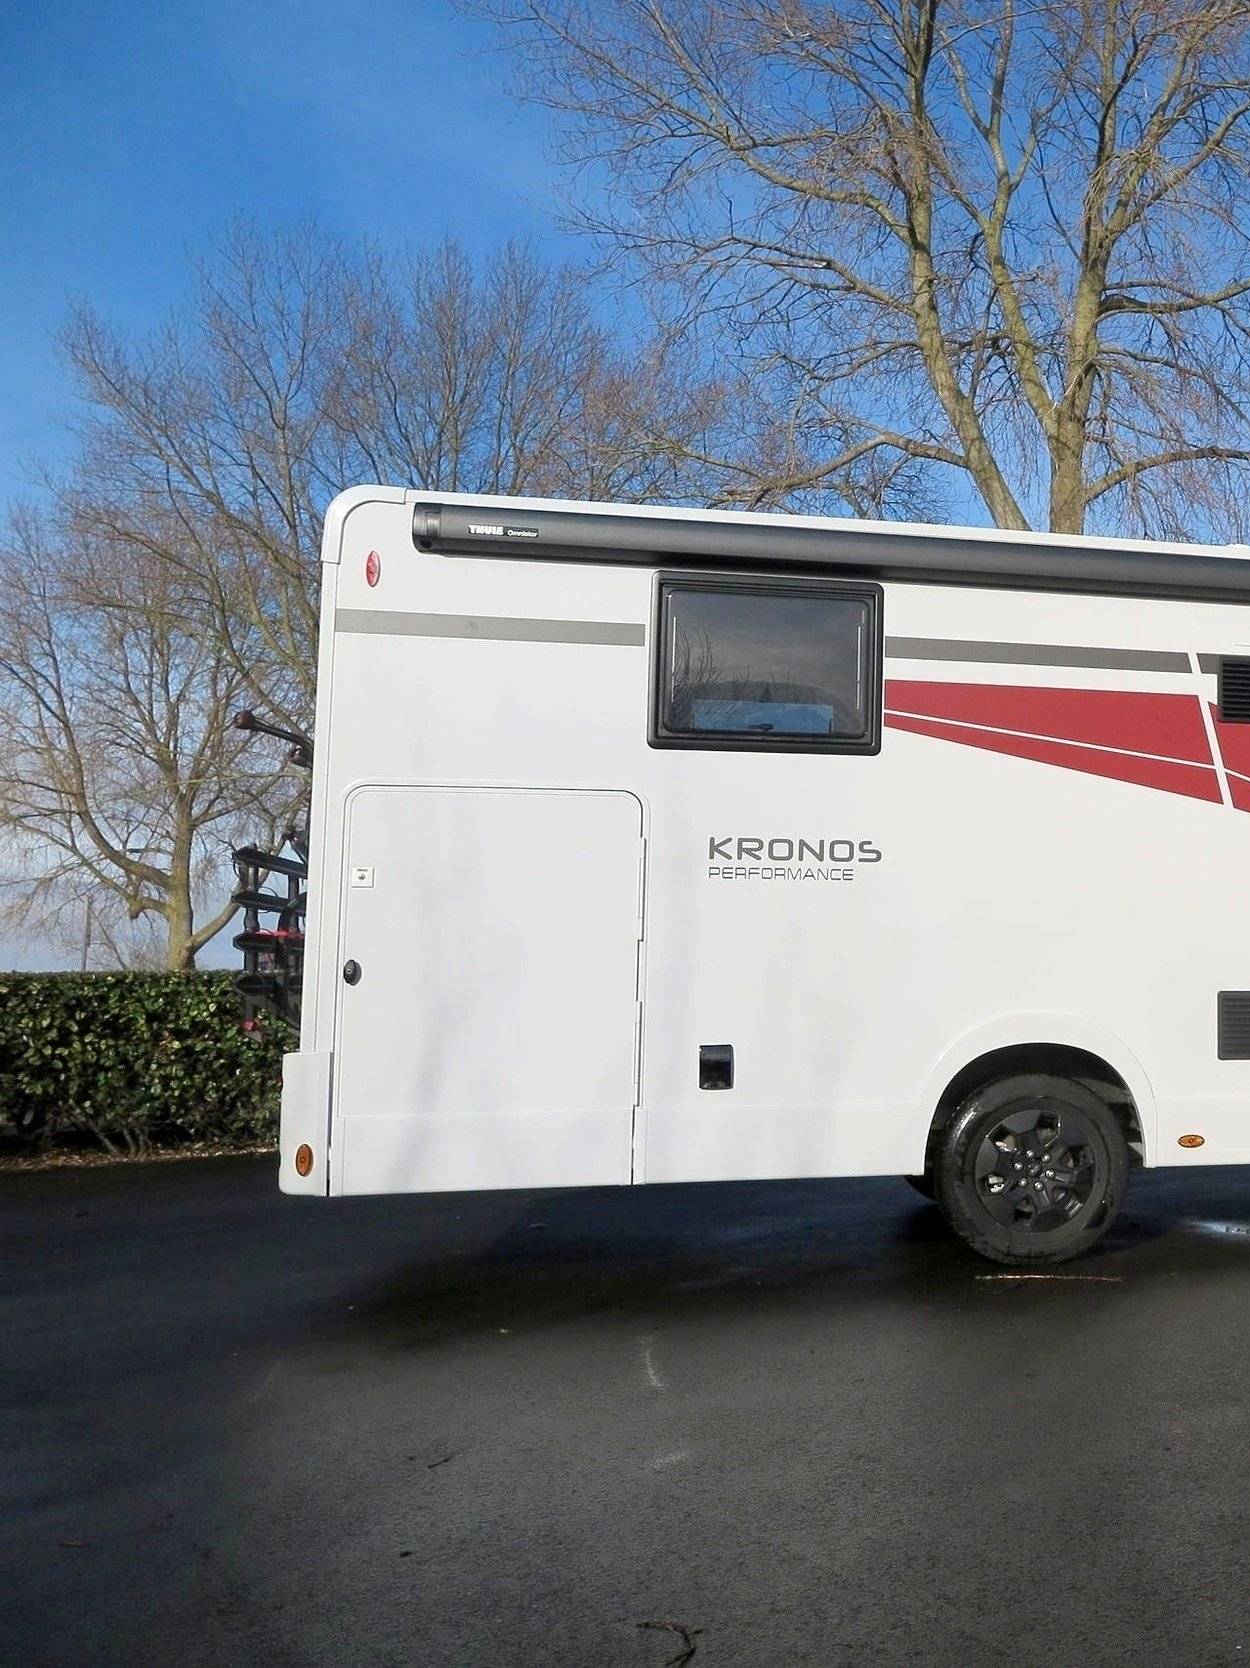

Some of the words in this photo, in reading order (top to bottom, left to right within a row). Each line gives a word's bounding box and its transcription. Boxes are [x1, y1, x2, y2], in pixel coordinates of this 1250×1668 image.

[468, 524, 504, 536] THULE
[708, 836, 882, 863] KRONOS
[708, 866, 854, 881] PERFORMANCE
